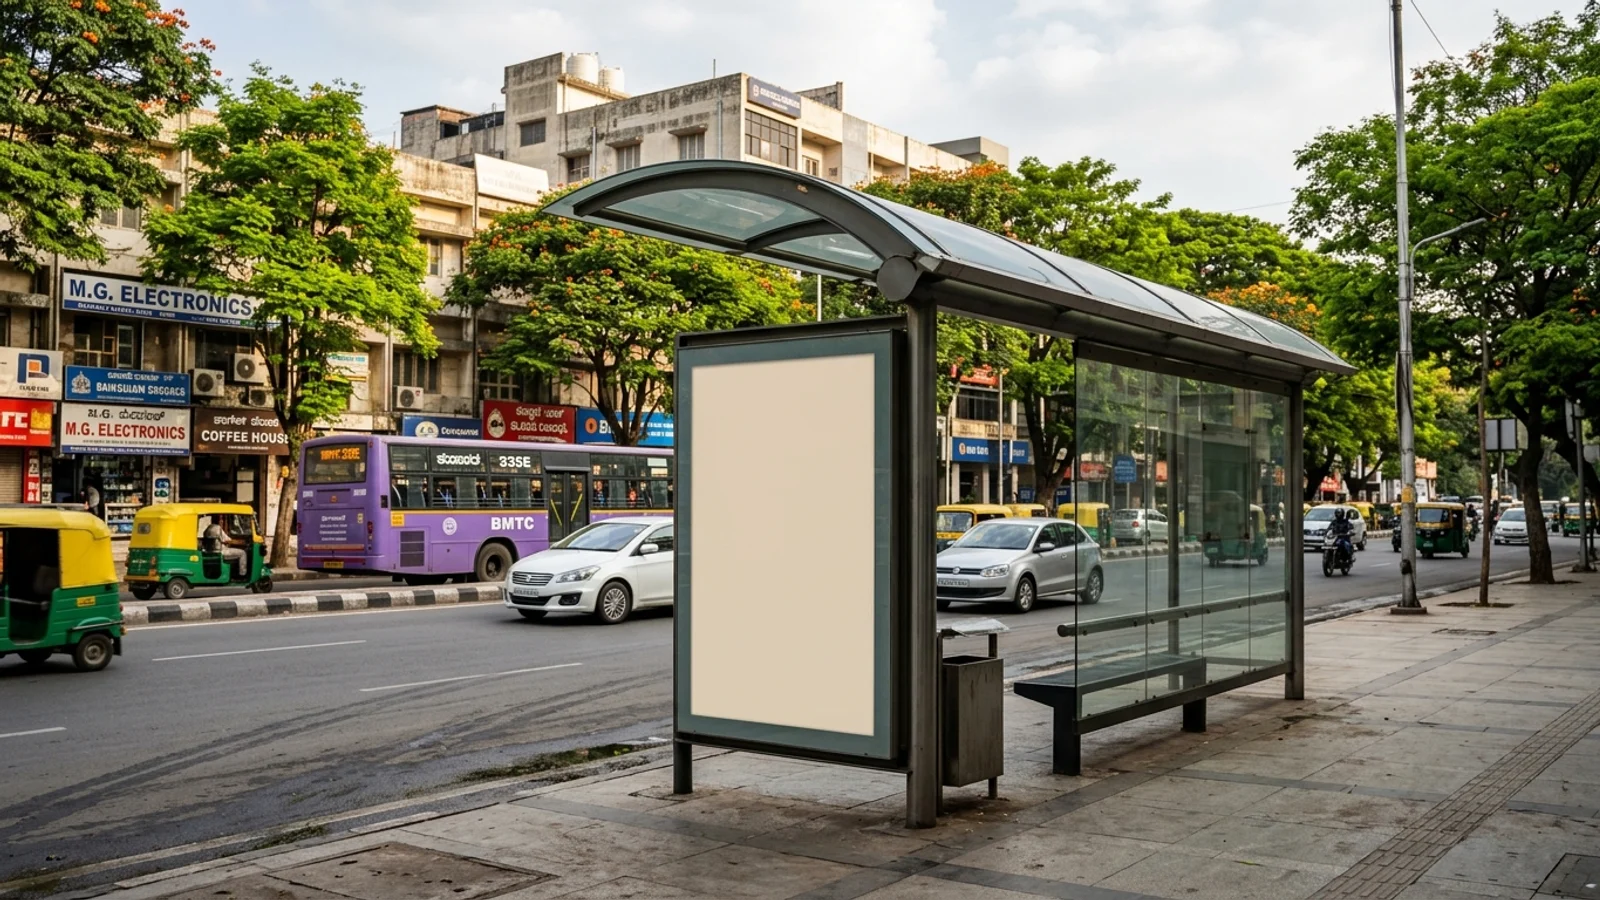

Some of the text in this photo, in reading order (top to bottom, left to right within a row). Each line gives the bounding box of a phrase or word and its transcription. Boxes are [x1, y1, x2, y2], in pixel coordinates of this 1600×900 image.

[70, 279, 113, 301] M.G.
[121, 285, 252, 316] ELECTRONICS
[65, 422, 186, 440] M.G. ELECTRONICS
[201, 429, 249, 443] COFFEE
[491, 516, 535, 531] BMTC
